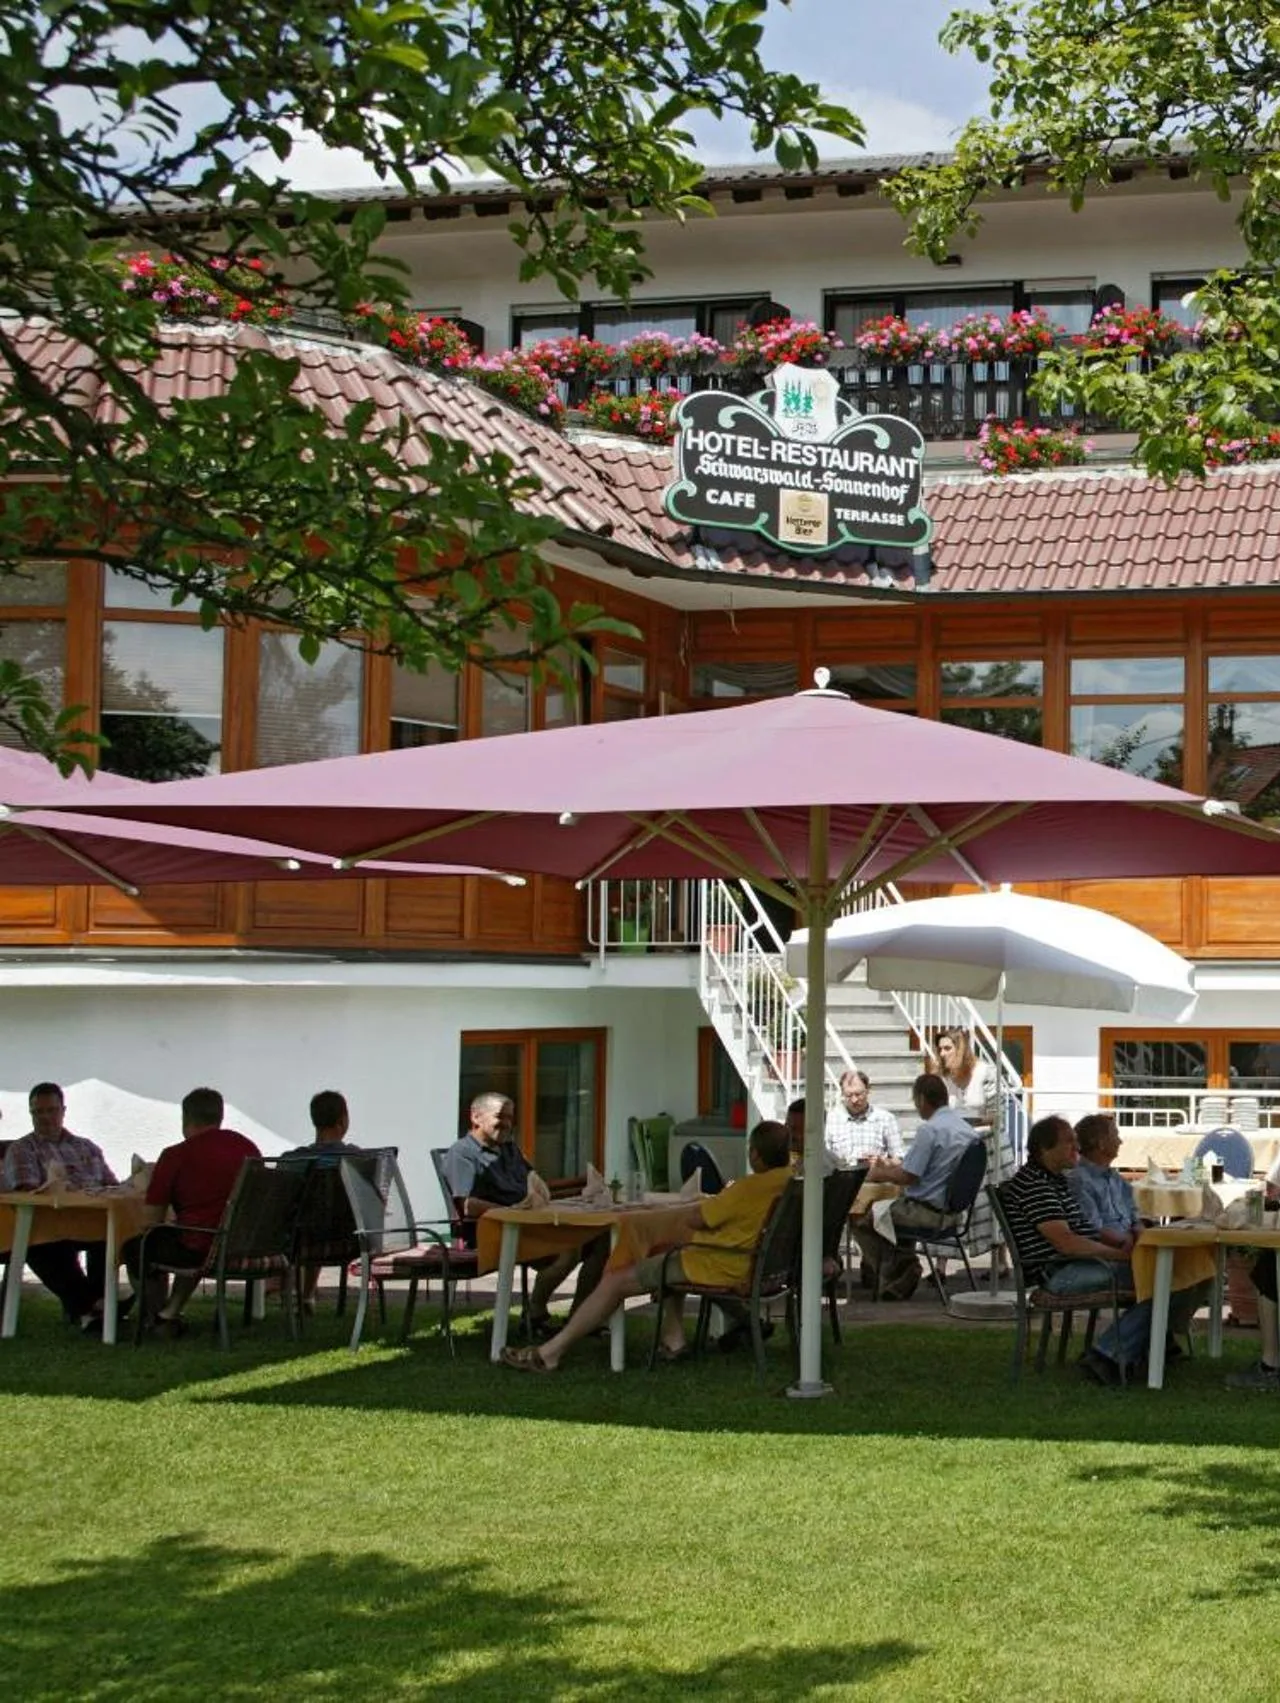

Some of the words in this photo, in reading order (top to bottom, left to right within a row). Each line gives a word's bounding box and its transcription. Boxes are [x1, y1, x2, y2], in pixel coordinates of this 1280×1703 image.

[686, 430, 918, 478] HOTEL-RESTAURANT
[706, 489, 756, 509] CAFE
[834, 508, 905, 526] TERRASSE
